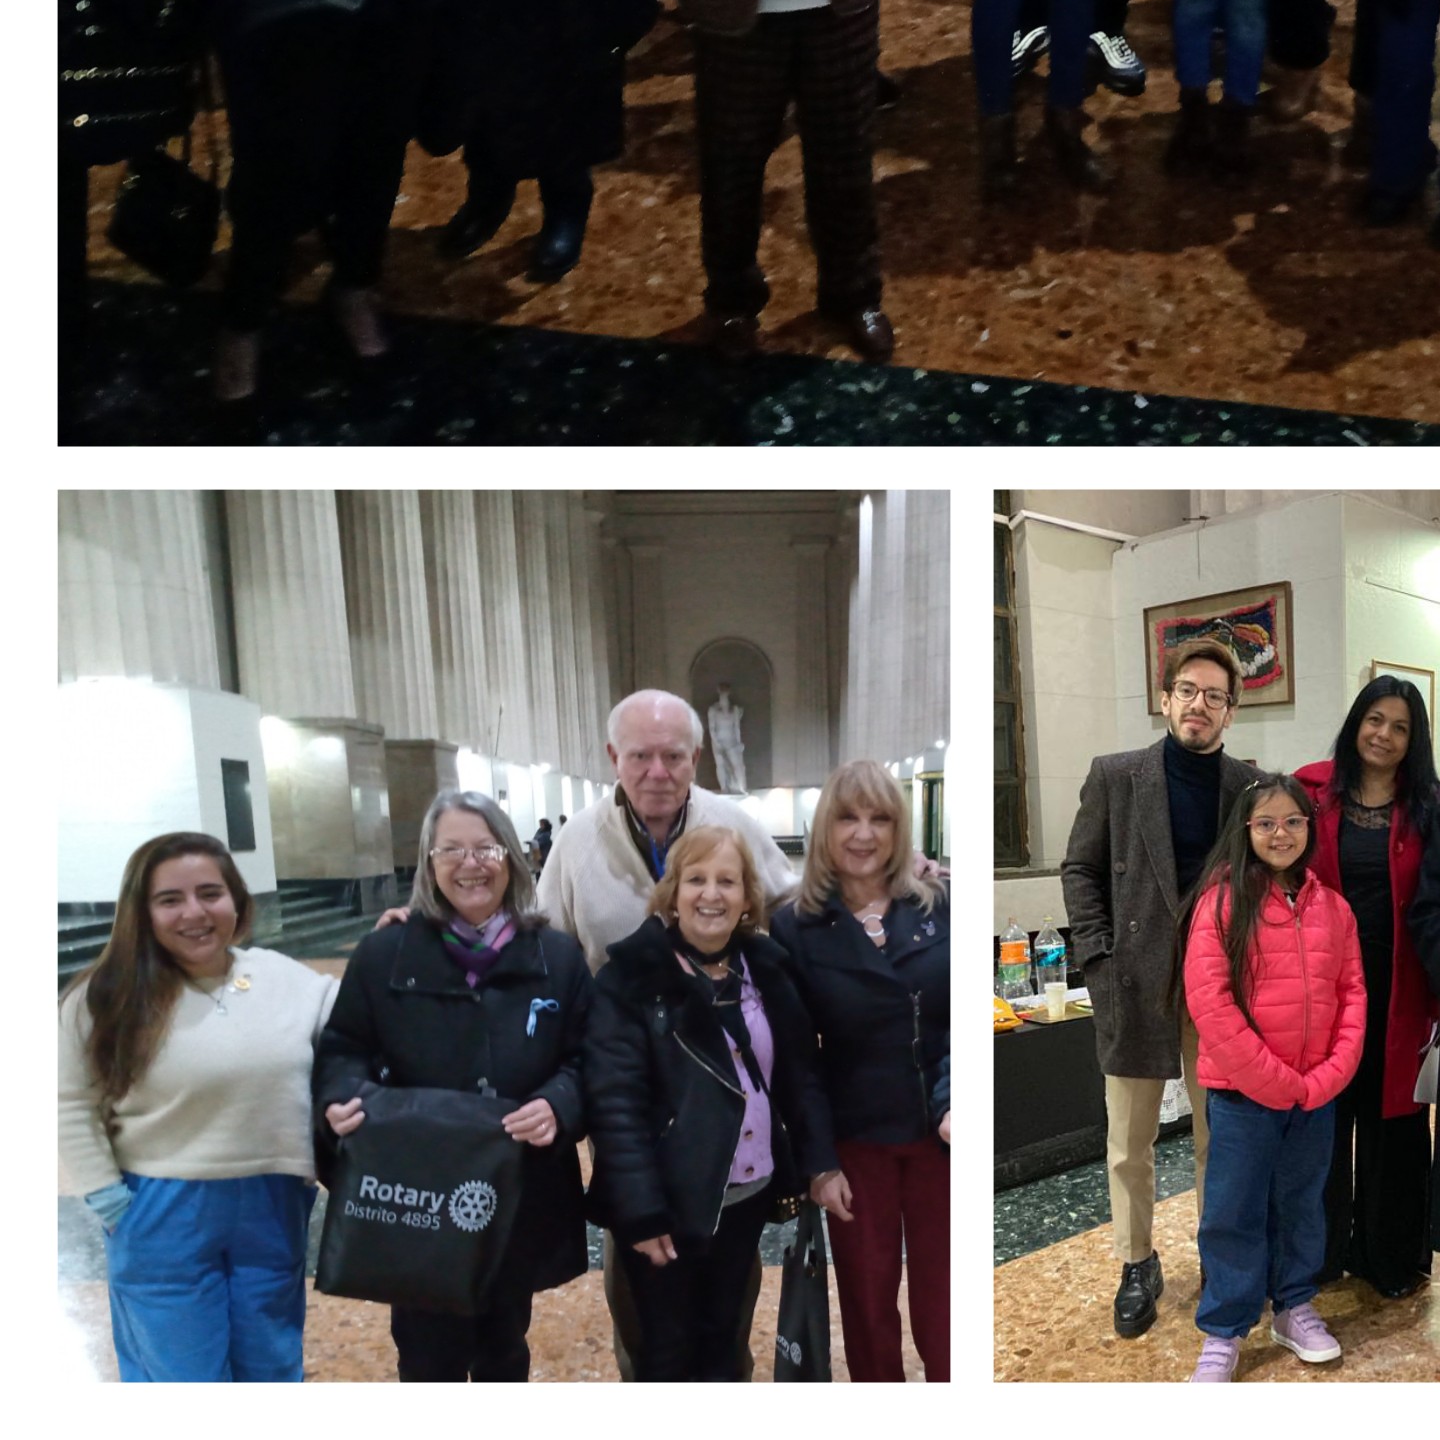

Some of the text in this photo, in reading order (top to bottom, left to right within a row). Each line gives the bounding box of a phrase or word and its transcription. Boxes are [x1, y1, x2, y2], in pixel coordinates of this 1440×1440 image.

[359, 1174, 445, 1214] Rotary
[344, 1199, 441, 1230] Distrito 4895
